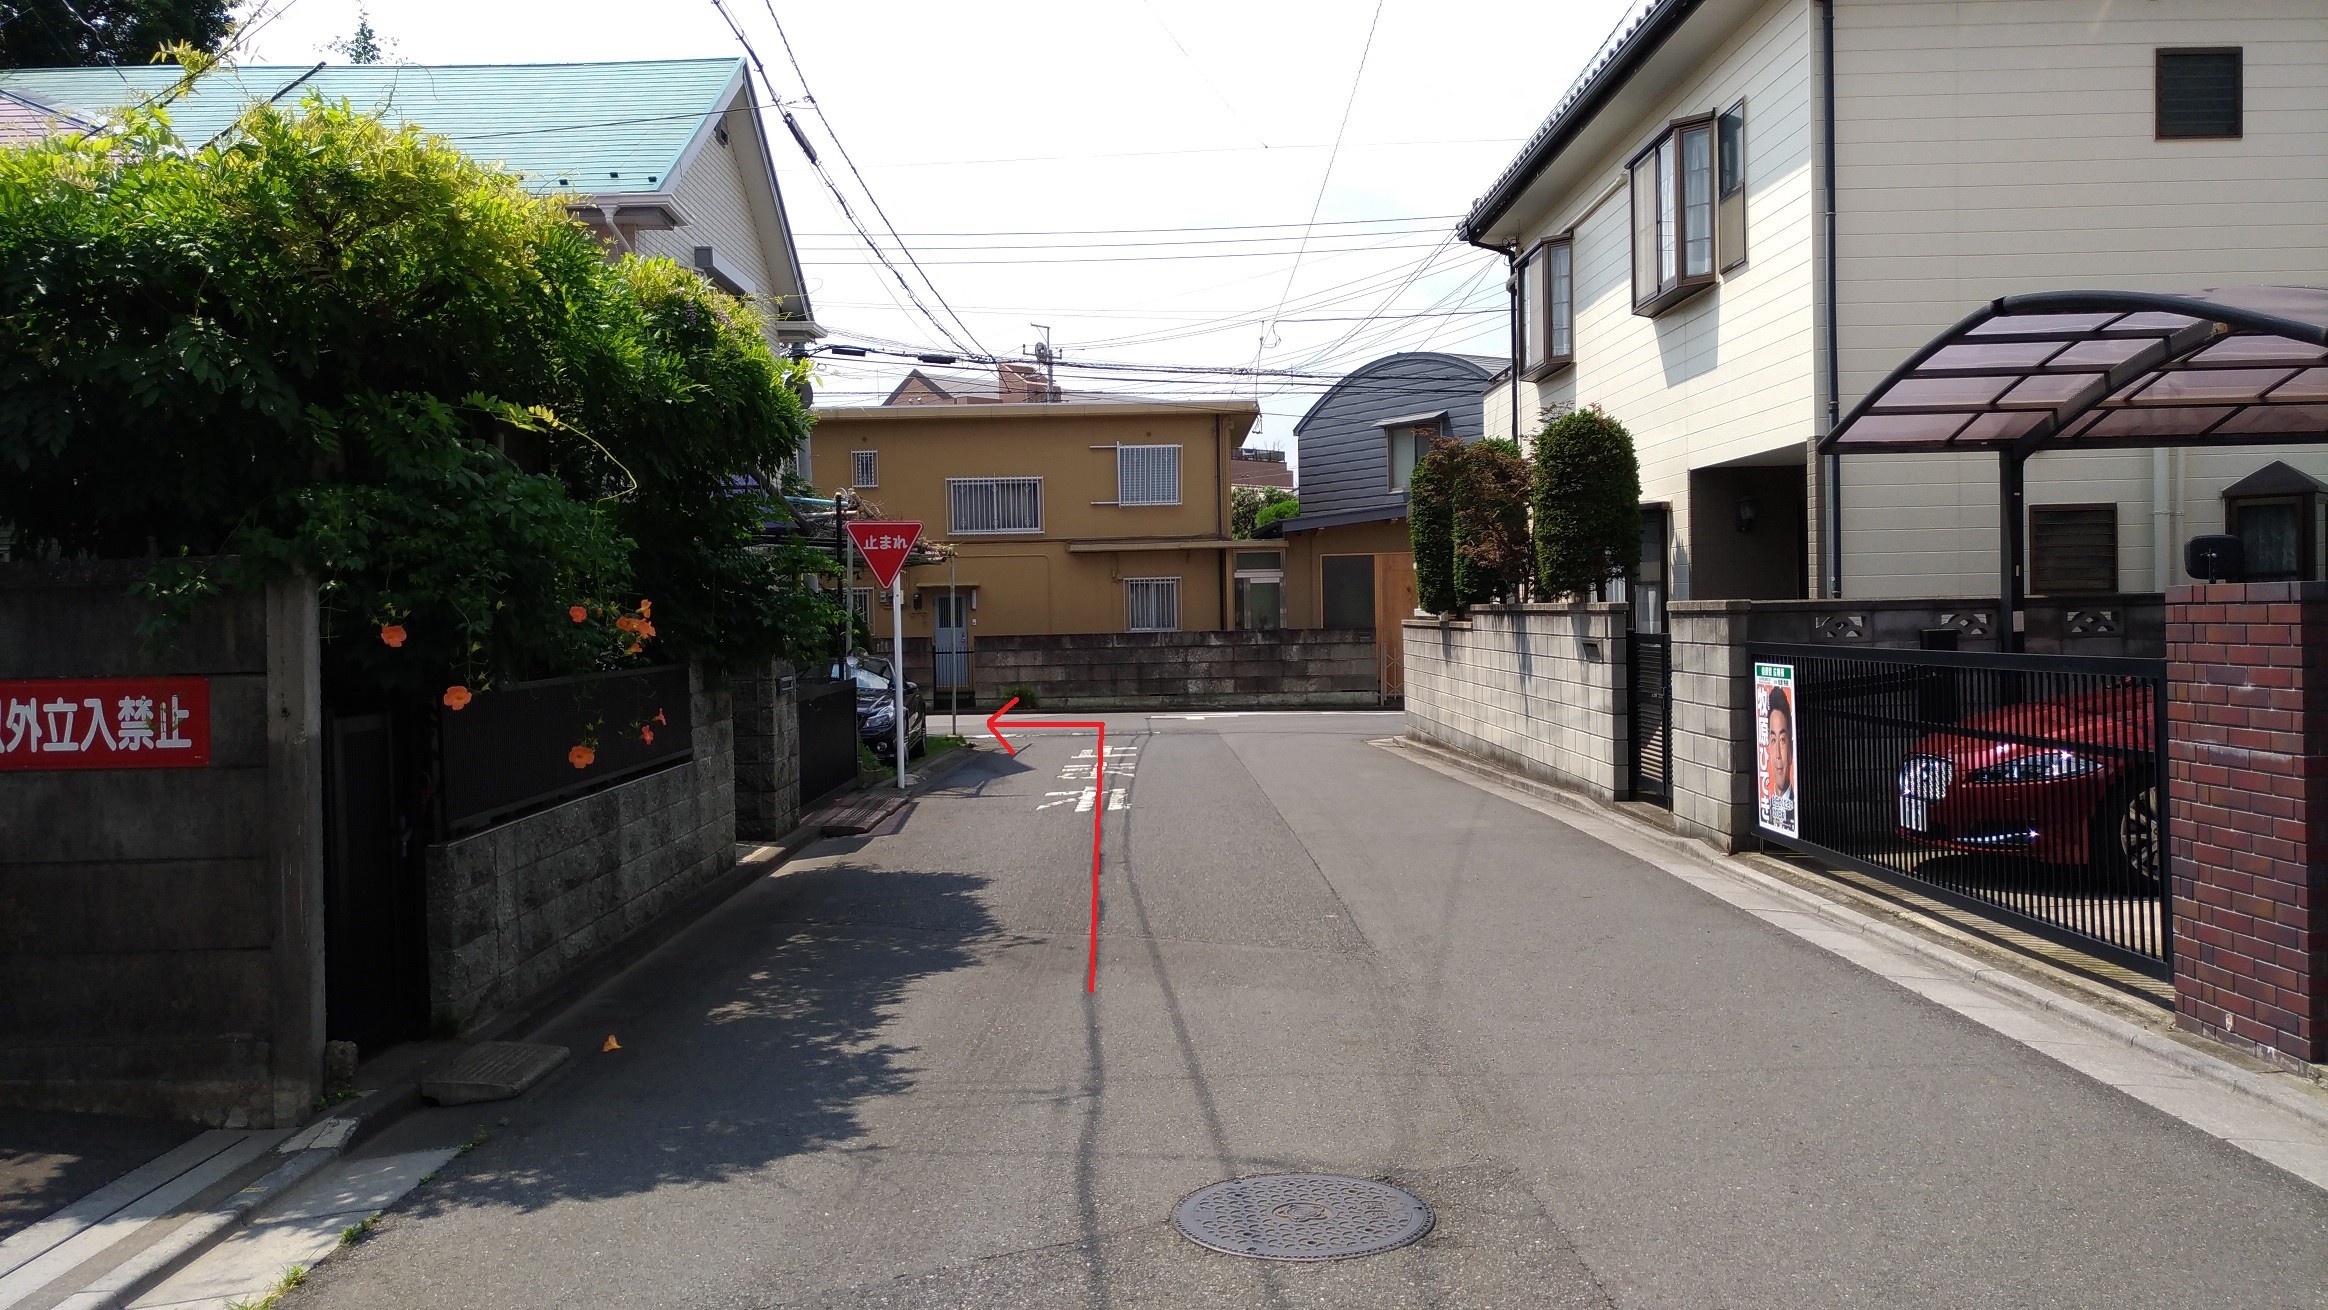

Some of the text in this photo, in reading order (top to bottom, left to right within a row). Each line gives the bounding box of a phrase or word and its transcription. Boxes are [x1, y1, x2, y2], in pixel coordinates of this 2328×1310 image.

[863, 534, 908, 550] 止まれ
[0, 694, 192, 753] 外立入禁止
